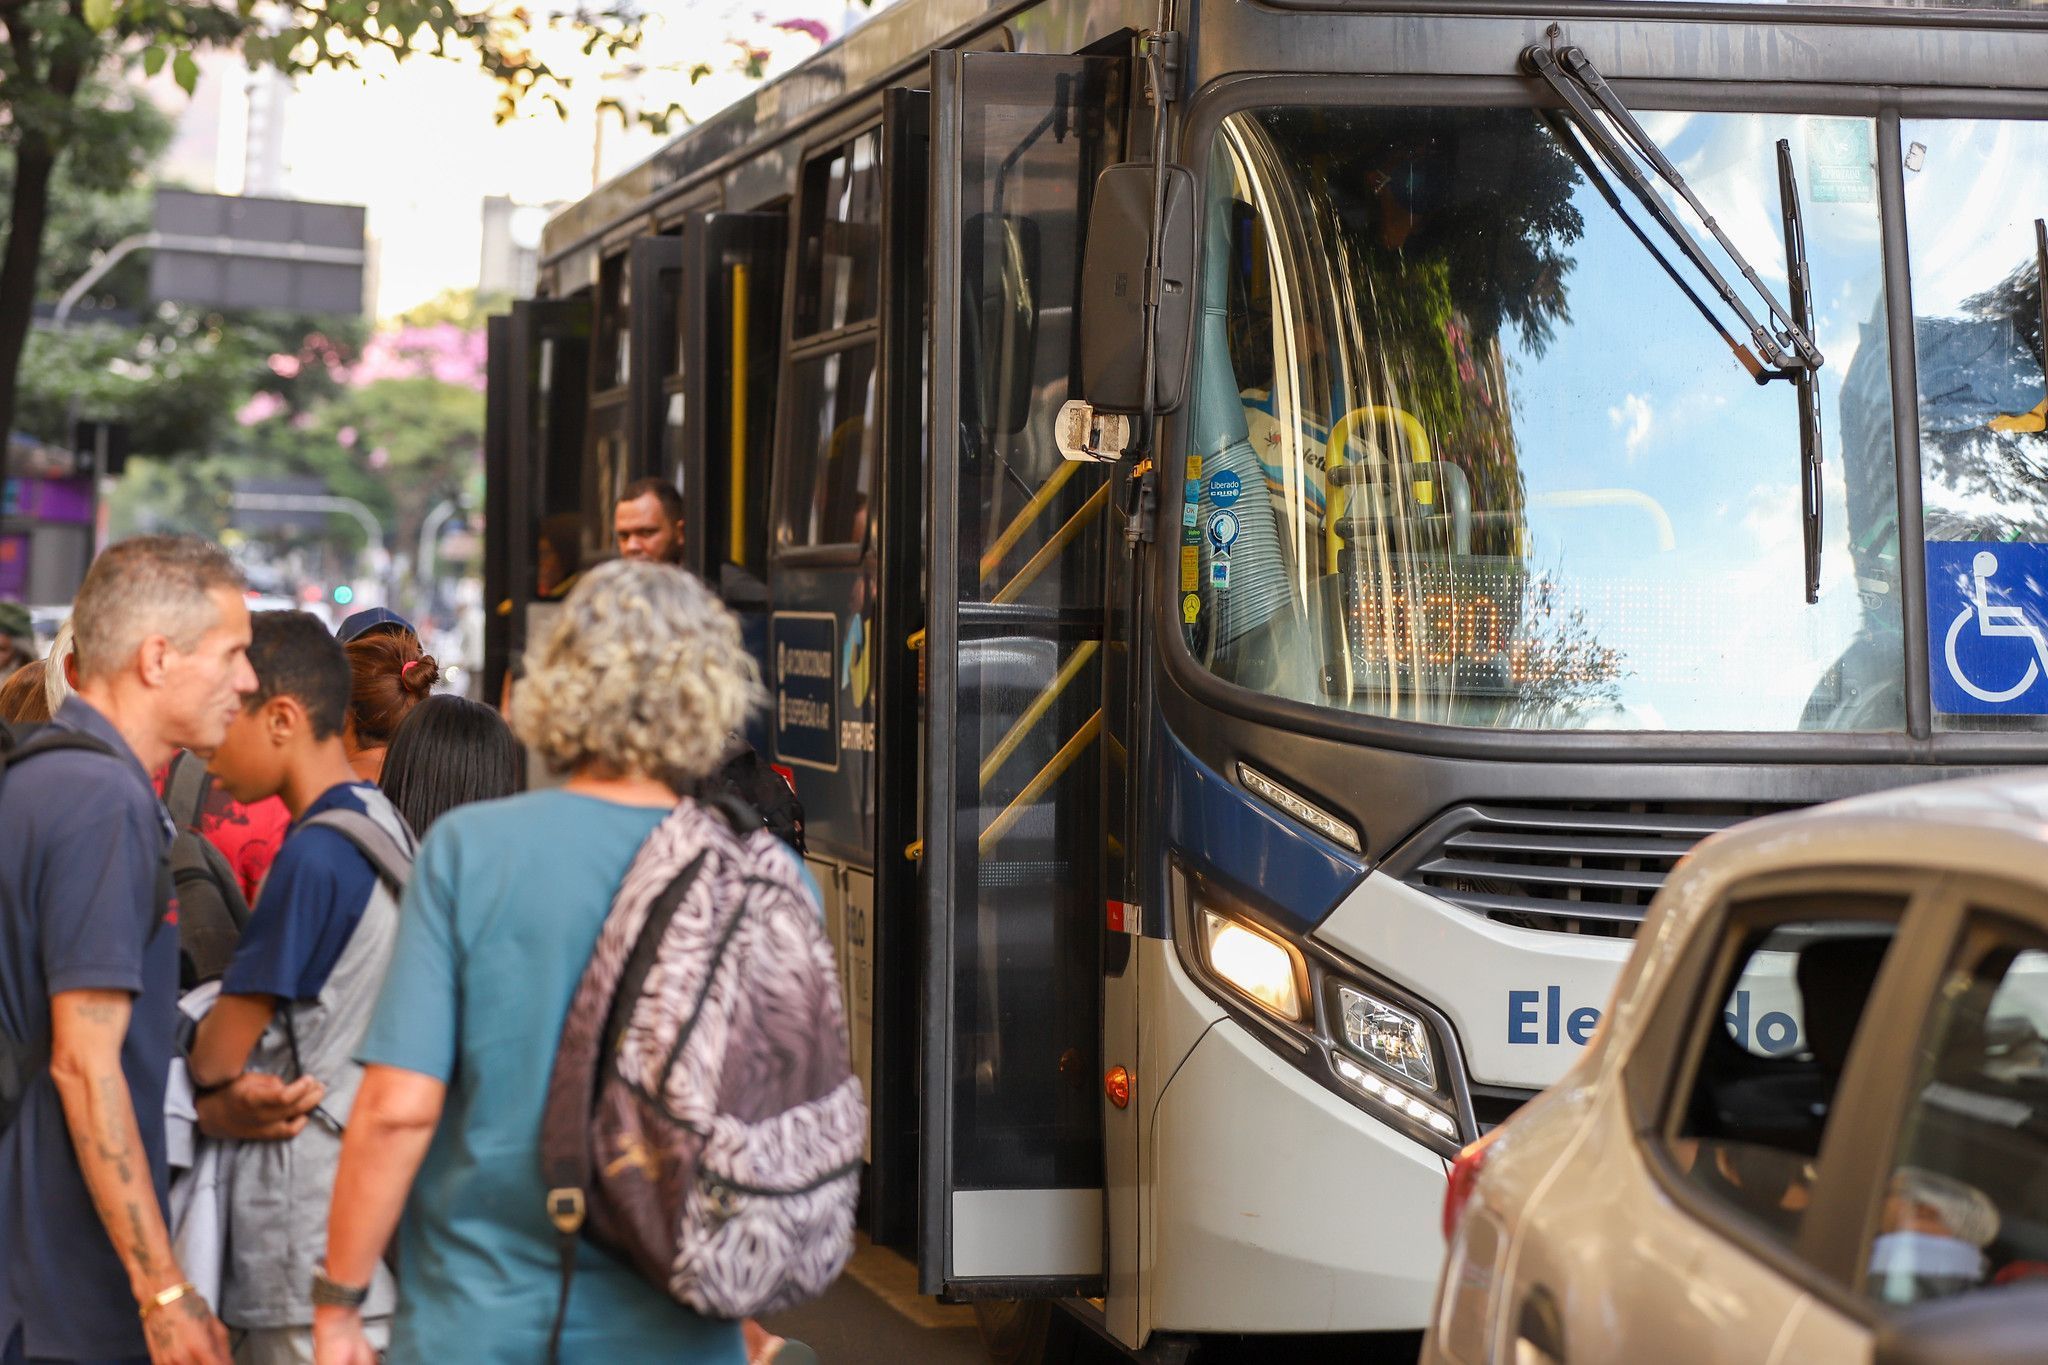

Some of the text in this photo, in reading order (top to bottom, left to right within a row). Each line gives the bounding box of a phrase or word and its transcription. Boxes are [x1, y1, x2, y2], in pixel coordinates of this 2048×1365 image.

[1210, 481, 1239, 490] Liberado
[1352, 594, 1498, 662] 1030
[1508, 986, 1799, 1053] Eledo
